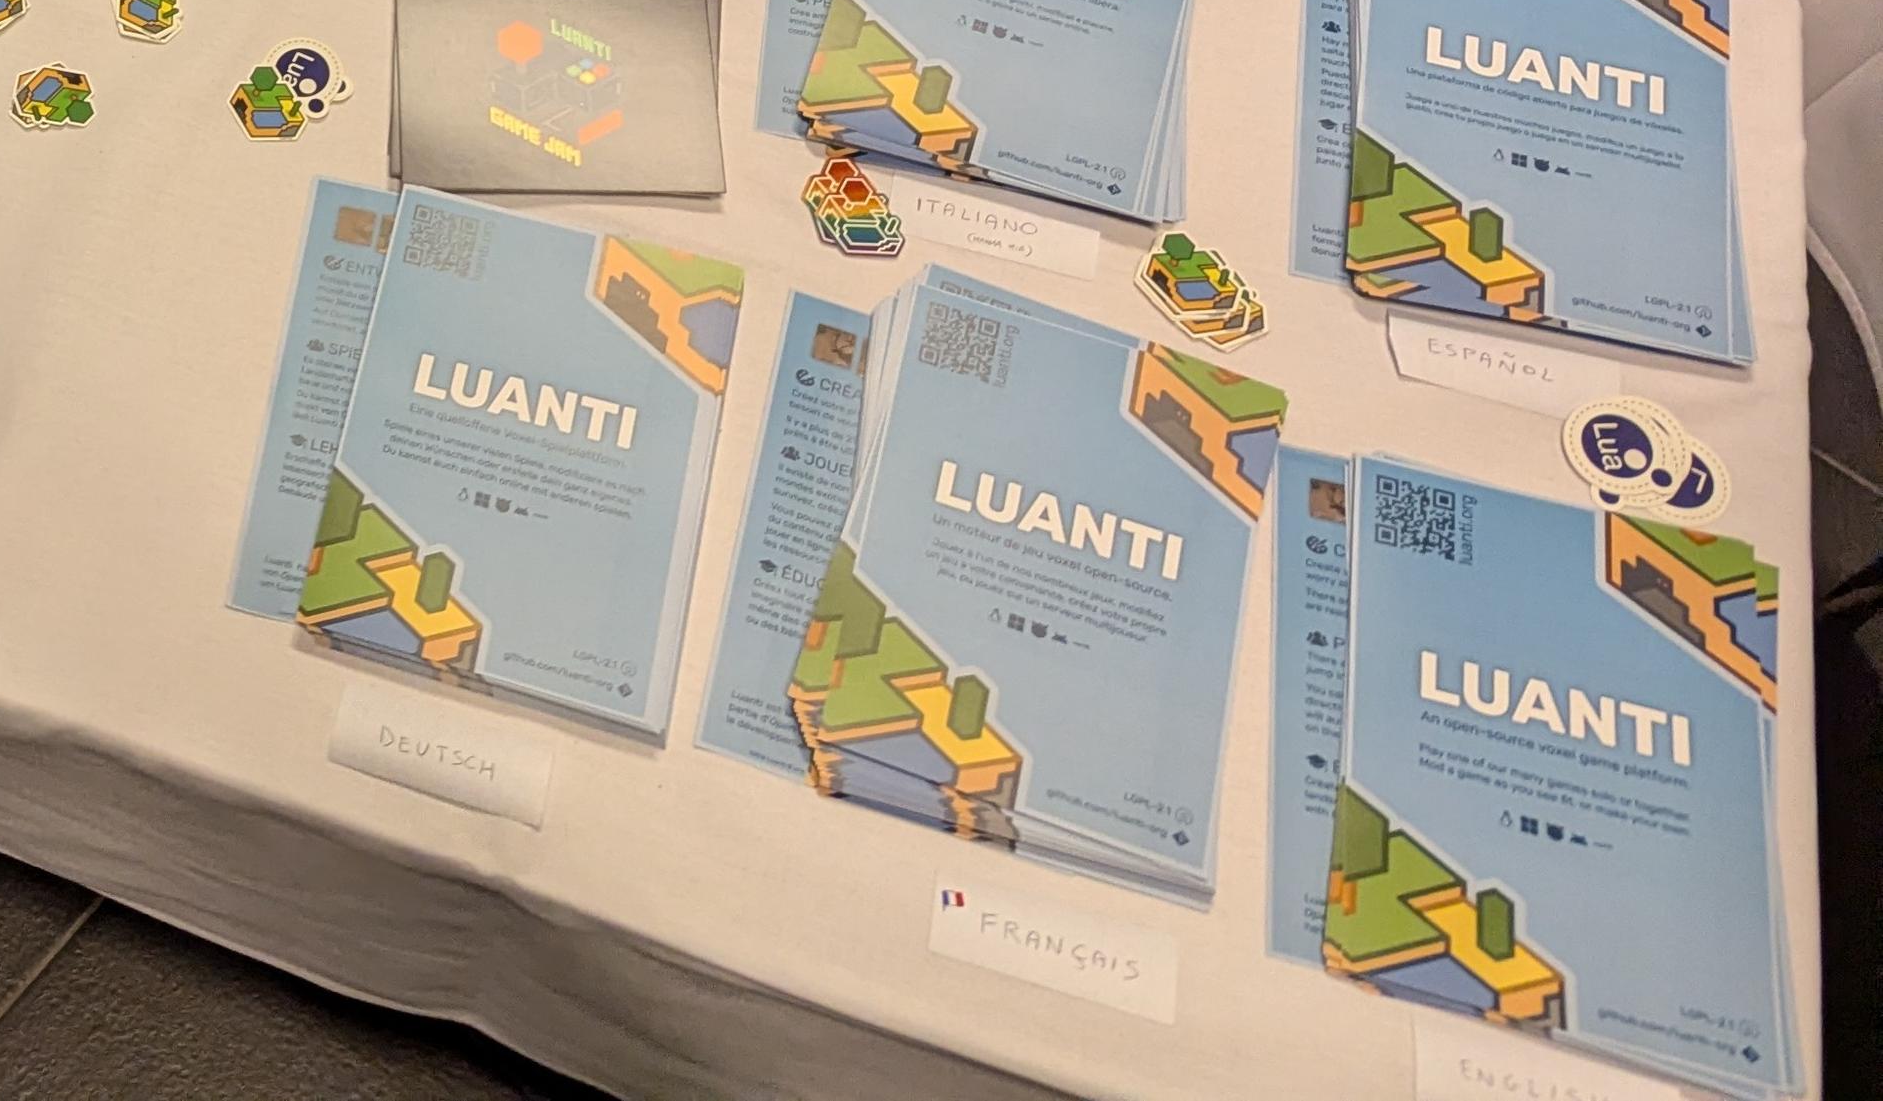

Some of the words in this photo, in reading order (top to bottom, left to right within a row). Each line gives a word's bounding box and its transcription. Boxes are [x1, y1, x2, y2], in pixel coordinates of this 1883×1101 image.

[550, 18, 612, 61] LUANTI
[1426, 26, 1665, 116] LUANTI
[1427, 71, 1481, 92] plataforma
[1483, 83, 1495, 94] de
[1569, 102, 1591, 116] para
[1593, 107, 1628, 124] juegos
[1630, 116, 1642, 127] de
[490, 106, 542, 146] GAME
[544, 136, 582, 167] JAM
[916, 197, 1039, 236] ITALIANO
[994, 324, 1022, 389] luanti.org
[1427, 337, 1555, 383] ESPAÑOL
[413, 353, 638, 450] LUANTI
[1593, 422, 1623, 471] Lua
[934, 460, 1184, 581] LUANTI
[954, 521, 1001, 544] moteur
[1003, 537, 1020, 550] de
[1021, 543, 1044, 559] jeu
[1046, 552, 1082, 572] voxel
[1460, 495, 1477, 566] luanti.org
[1420, 650, 1691, 767] LUANTI
[380, 725, 496, 781] DEUTSCH
[1419, 742, 1444, 759] Play
[1446, 750, 1469, 764] one
[1472, 756, 1485, 768] of
[1488, 762, 1507, 774] our
[1510, 766, 1544, 785] many
[1547, 777, 1588, 796] games
[1420, 710, 1441, 726] An
[1443, 716, 1535, 750] open-source
[1539, 742, 1576, 759] voxel
[1579, 751, 1620, 772] game
[980, 912, 1140, 981] FRANÇAIS
[1460, 1058, 1610, 1101] ENGLIS
